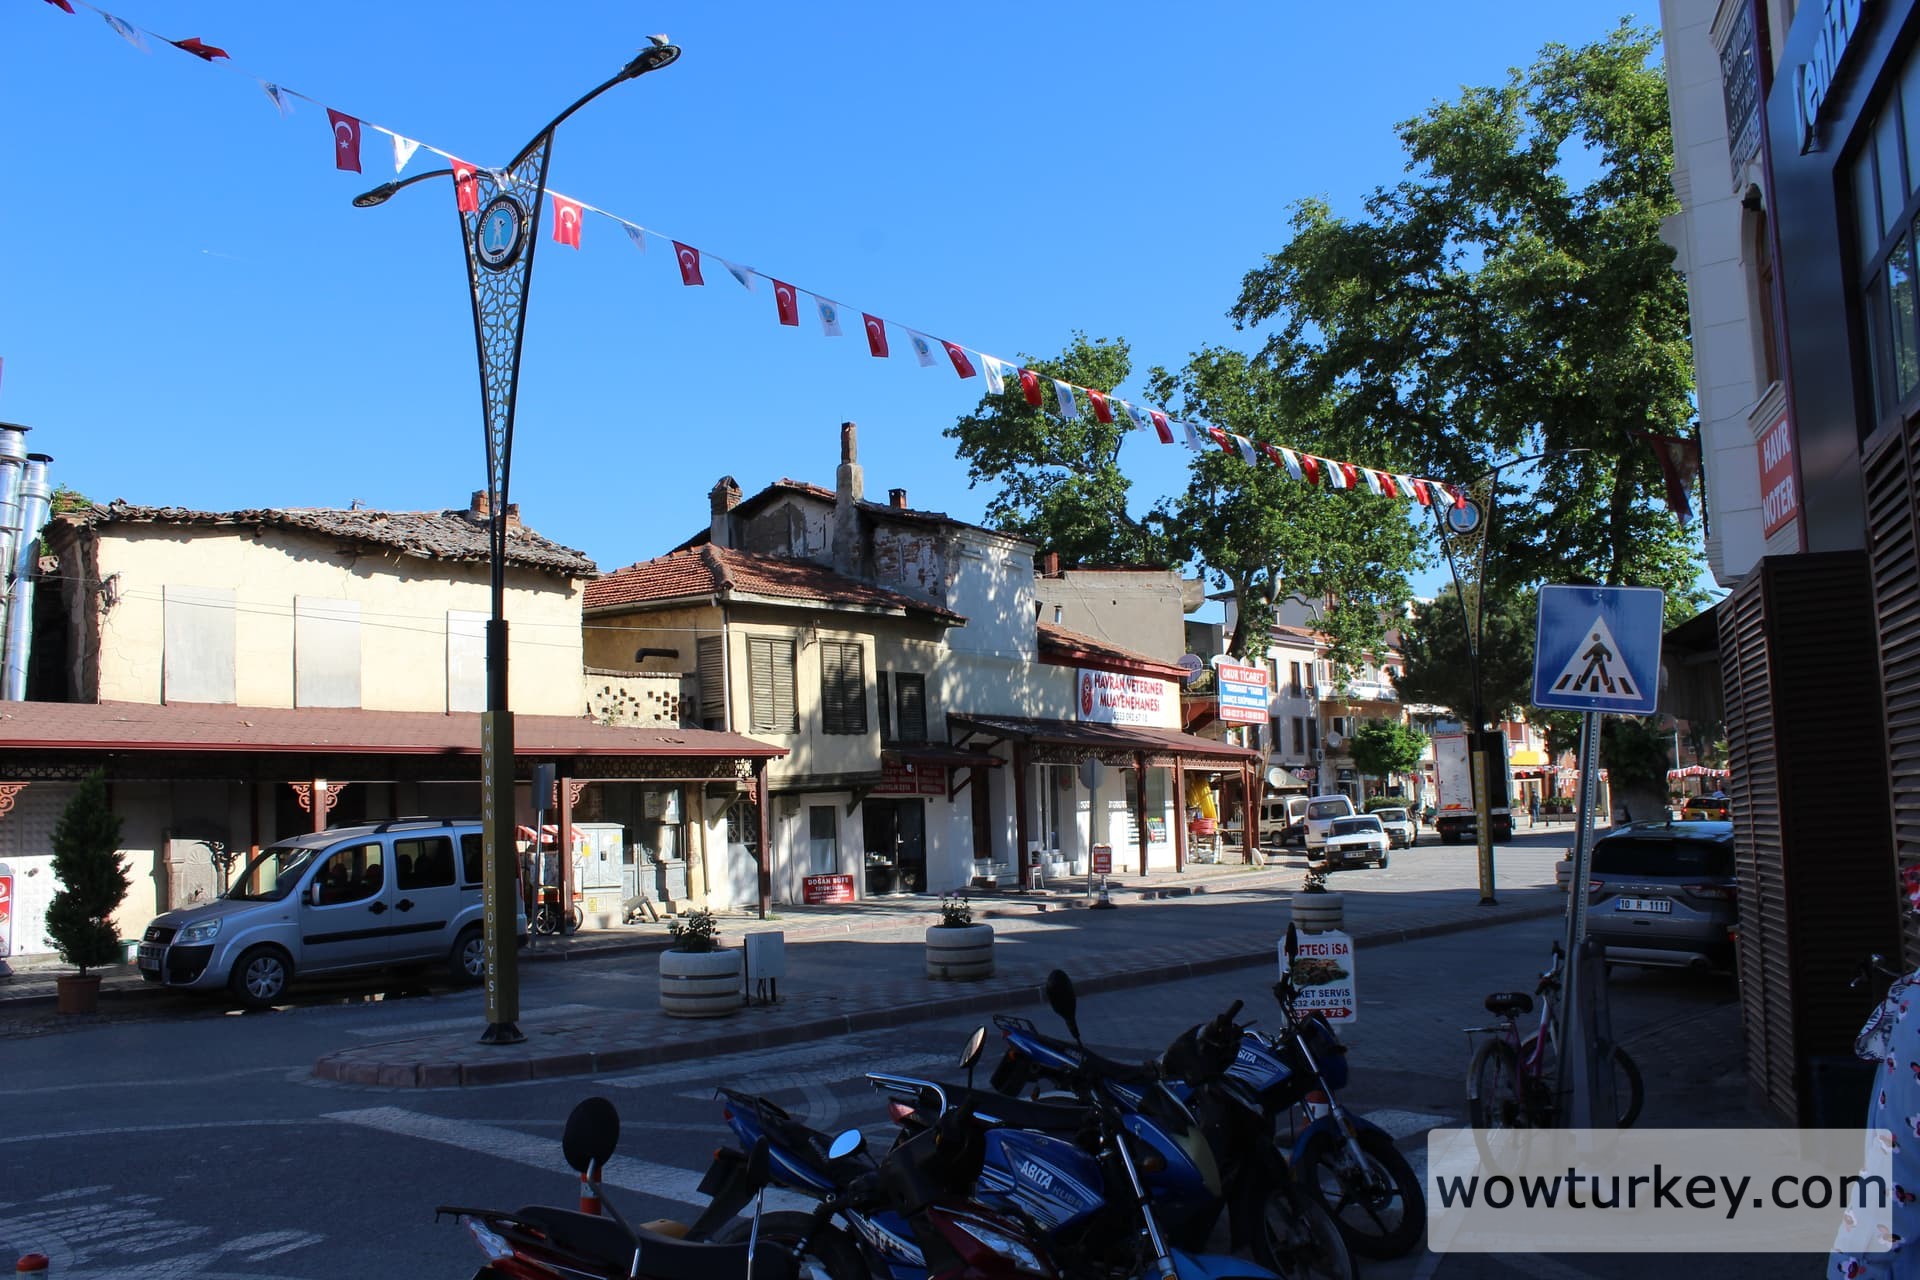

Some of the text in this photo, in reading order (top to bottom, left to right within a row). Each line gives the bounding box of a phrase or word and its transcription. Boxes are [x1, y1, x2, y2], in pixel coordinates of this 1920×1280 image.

[1094, 673, 1125, 690] HAVRAN
[807, 877, 831, 886] DOĞAN
[1621, 899, 1668, 912] 10 H 1111
[1342, 998, 1352, 1006] 16
[1329, 1009, 1344, 1017] 75
[1020, 1159, 1054, 1190] ABITA
